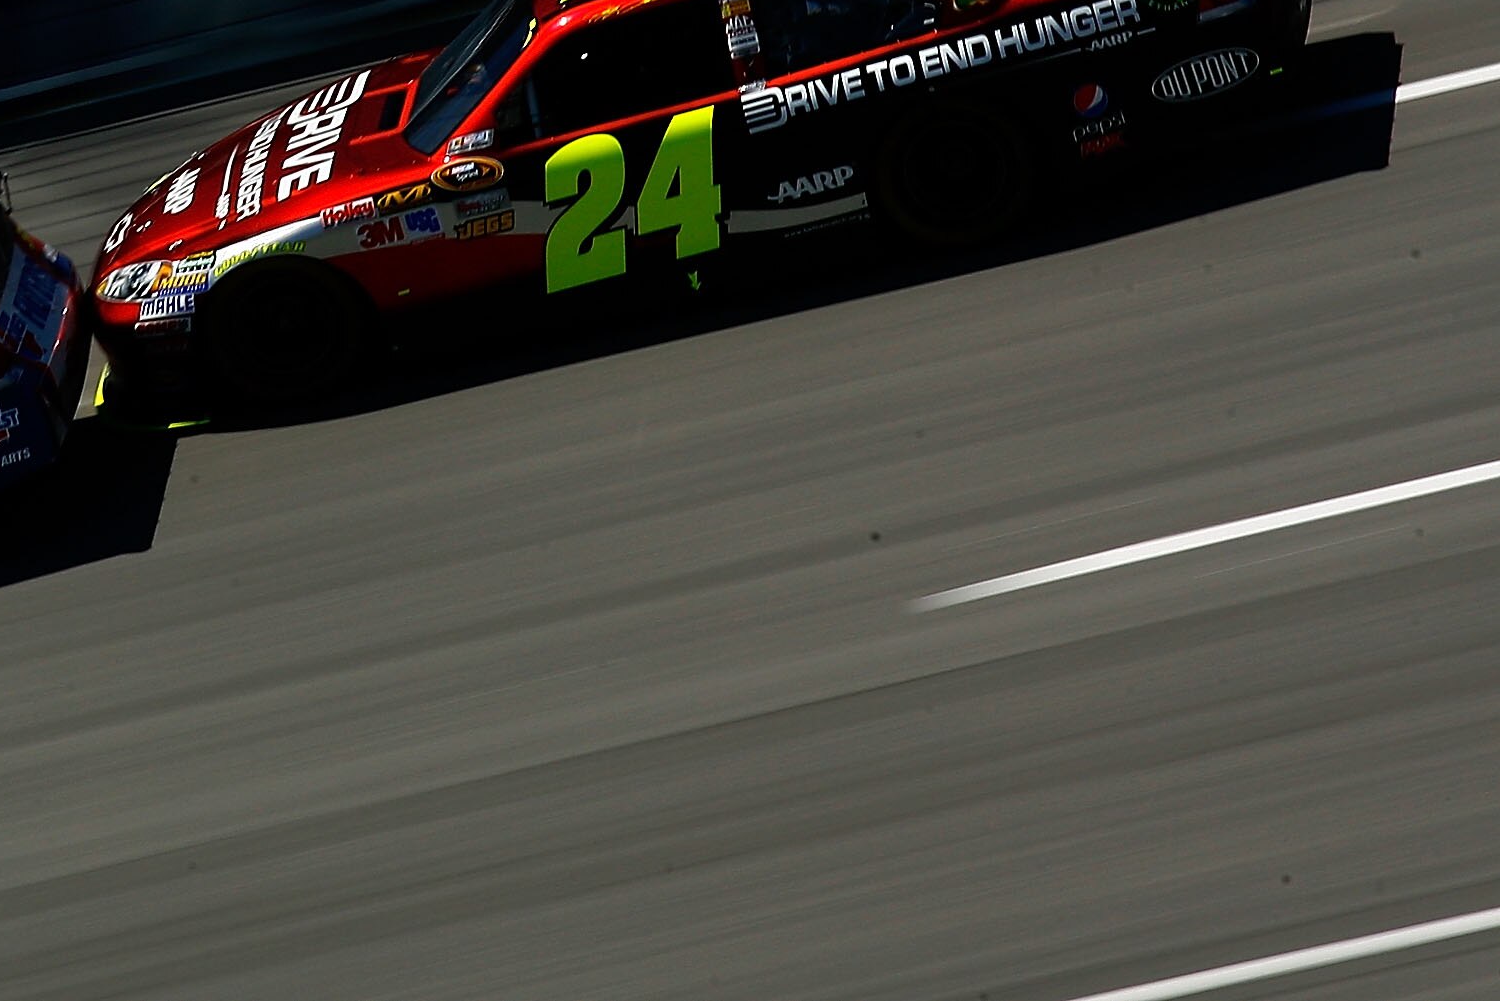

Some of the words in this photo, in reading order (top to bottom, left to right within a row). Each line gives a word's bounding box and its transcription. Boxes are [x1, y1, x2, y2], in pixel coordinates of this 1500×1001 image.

[741, 68, 865, 134] DRIVE
[867, 55, 916, 93] TO
[920, 35, 992, 80] END
[277, 70, 372, 202] DRIVE
[545, 105, 721, 294] 24
[767, 165, 854, 205] AARP
[322, 201, 374, 229] Holley
[454, 209, 515, 240] JEGS
[357, 216, 405, 248] 3M
[160, 273, 208, 289] MOOG
[142, 295, 195, 317] MAHLE
